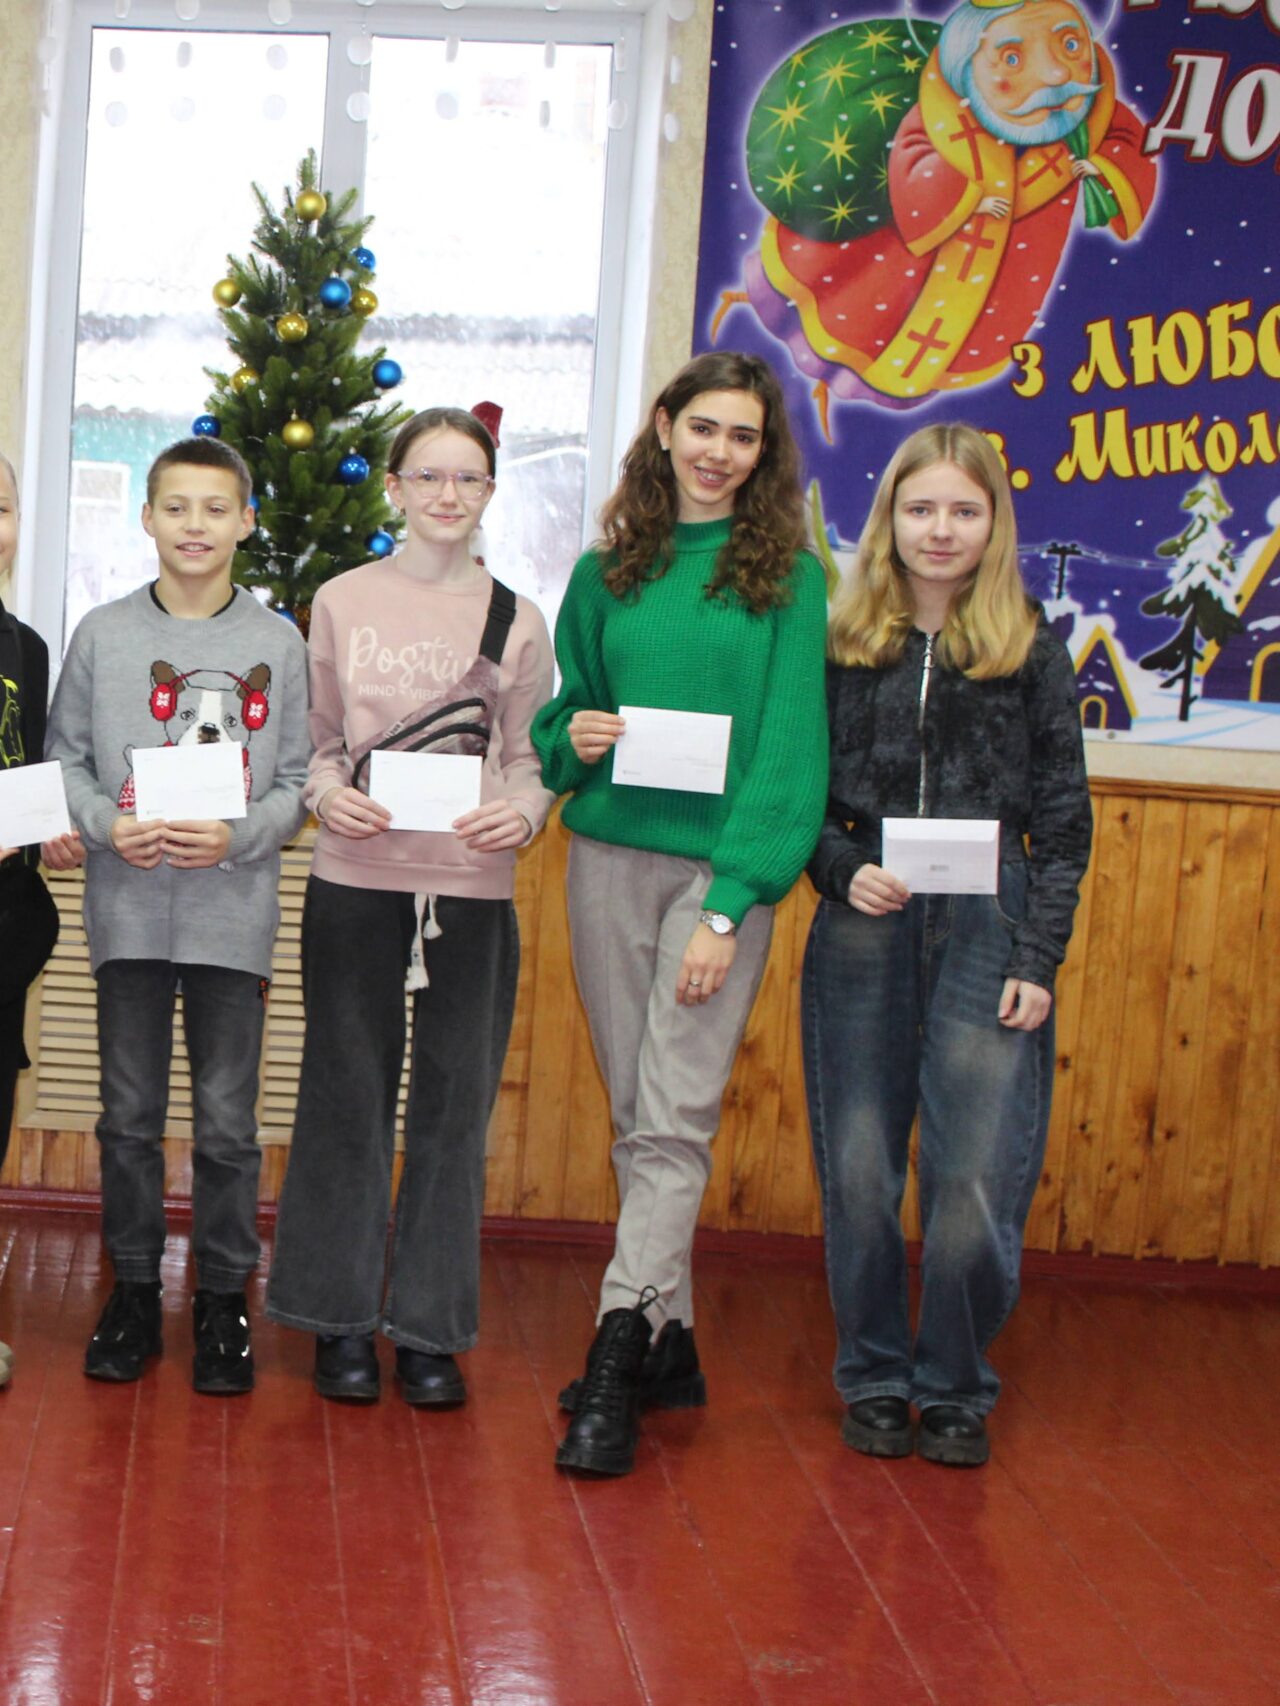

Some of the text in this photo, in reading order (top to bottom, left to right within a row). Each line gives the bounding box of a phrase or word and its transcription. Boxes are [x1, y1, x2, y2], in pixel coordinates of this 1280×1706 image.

[1142, 50, 1280, 163] ДО
[1055, 407, 1280, 483] Микол
[358, 684, 444, 700] MIND VIBE
